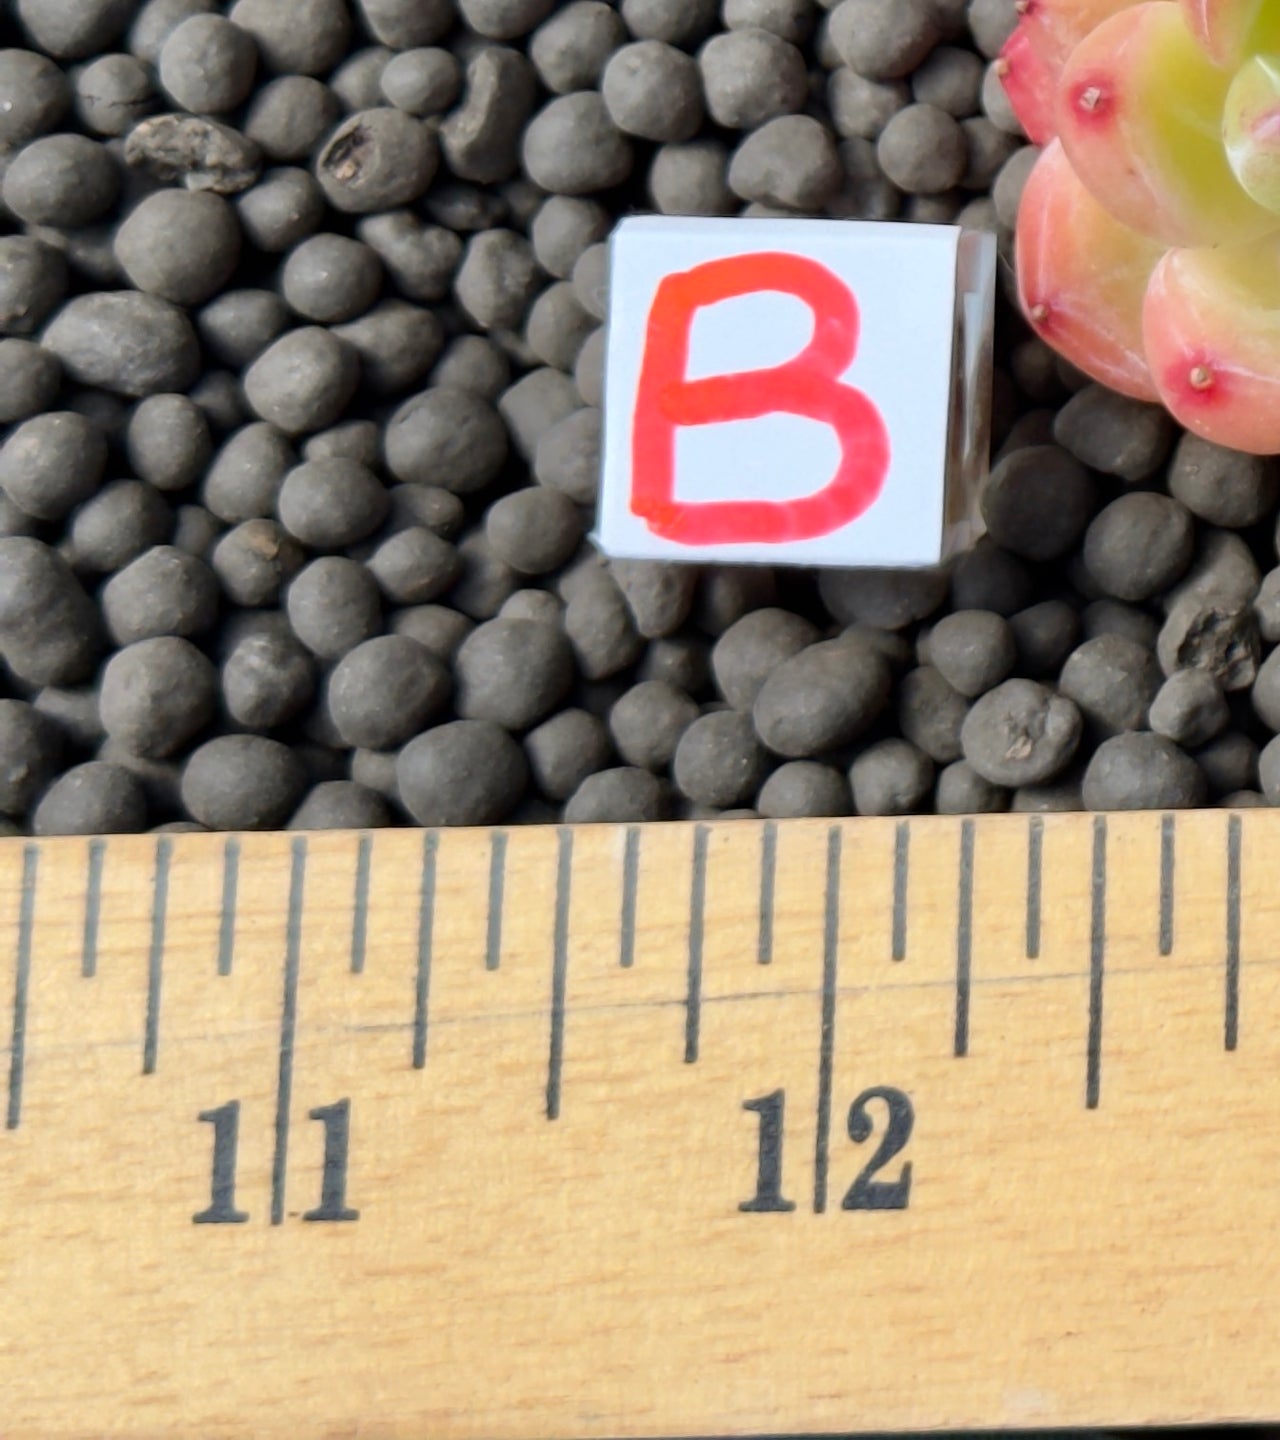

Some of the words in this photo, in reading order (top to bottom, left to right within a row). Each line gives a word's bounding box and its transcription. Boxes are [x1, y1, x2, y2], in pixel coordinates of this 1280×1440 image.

[631, 253, 888, 545] B
[192, 1100, 359, 1223] 11
[739, 1087, 915, 1213] 12
